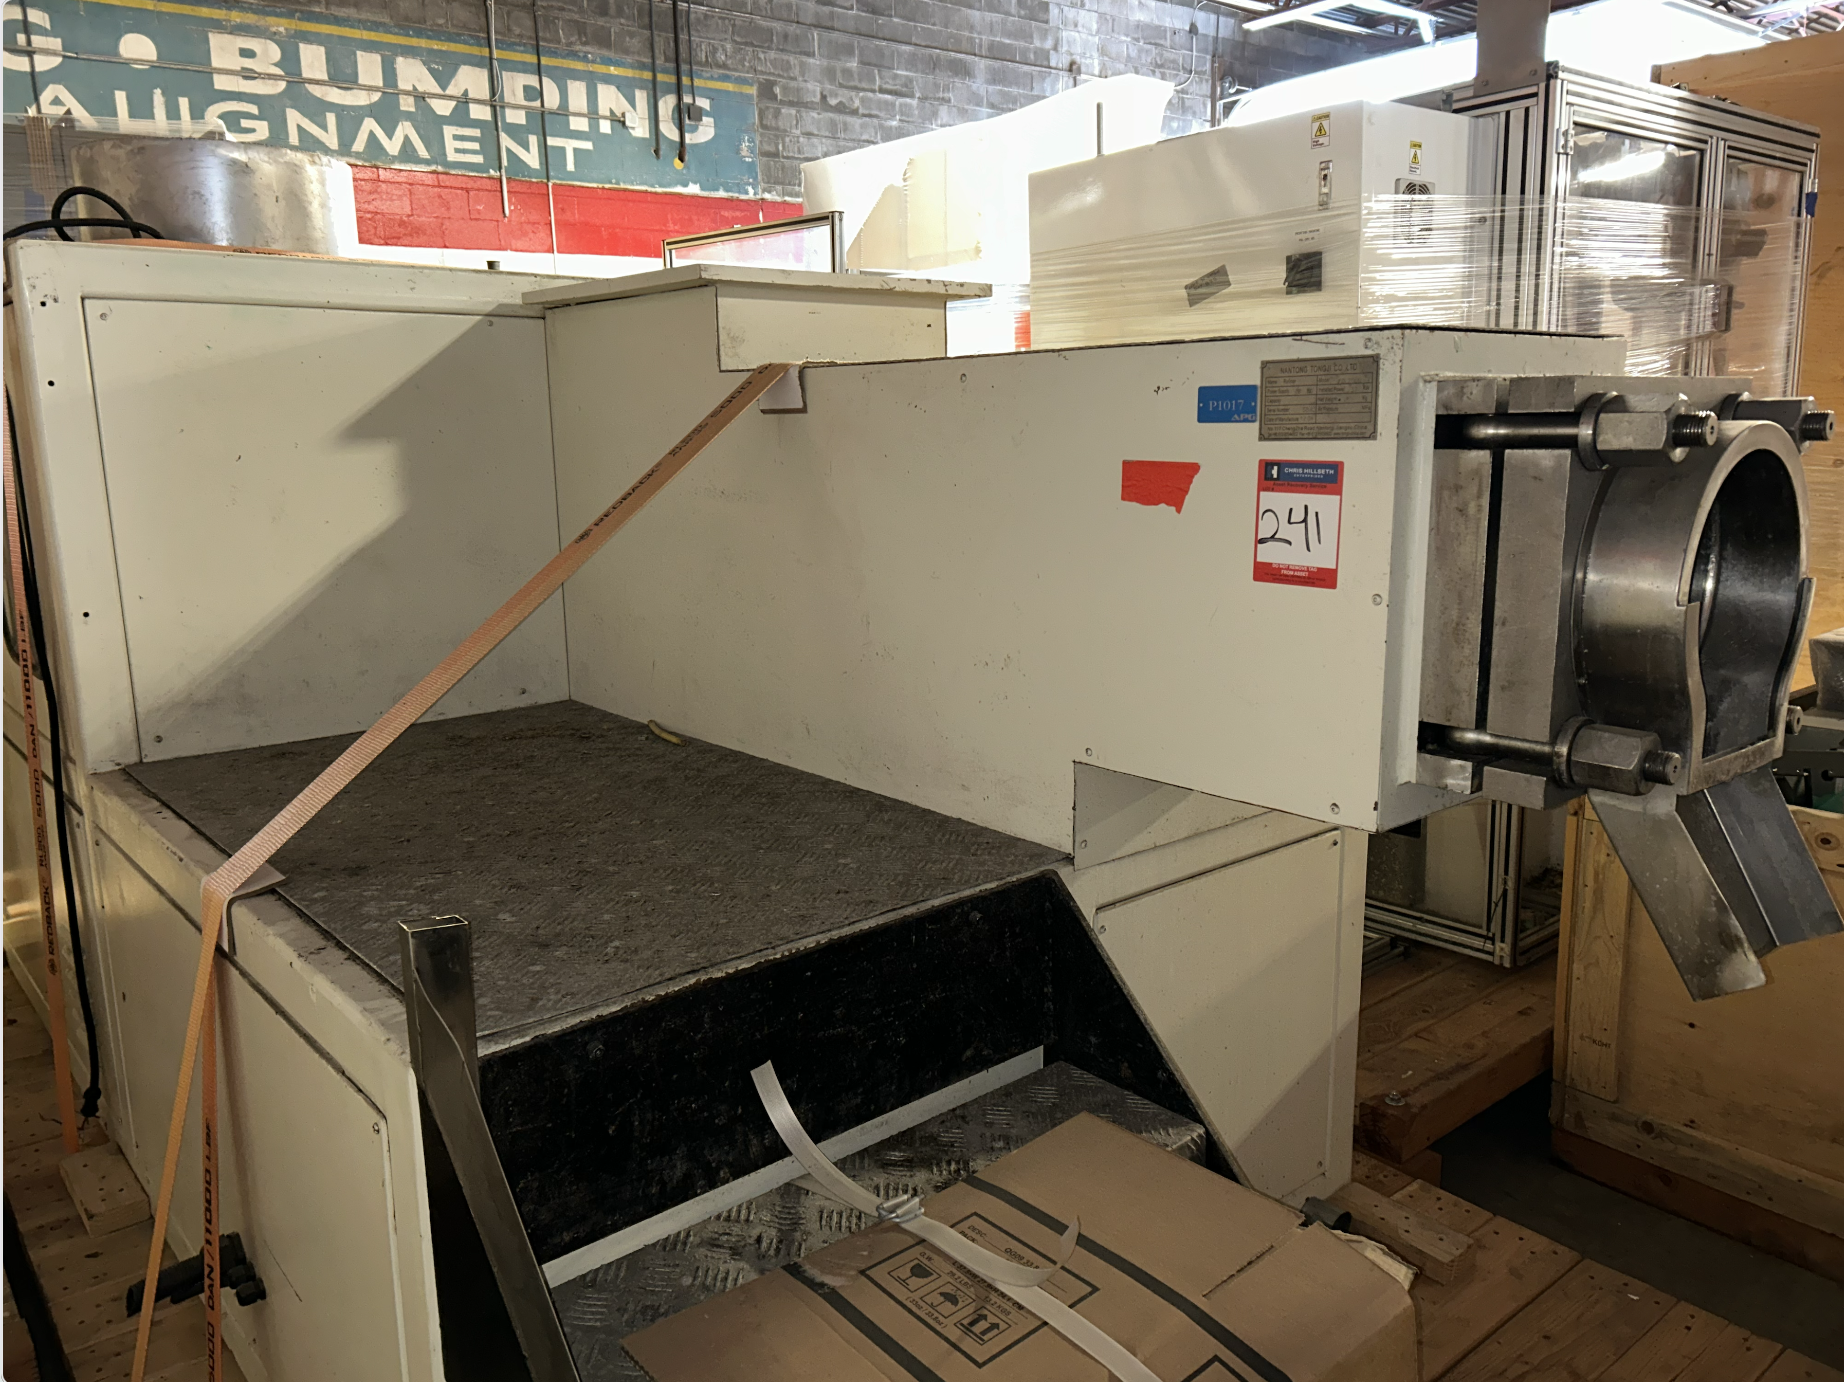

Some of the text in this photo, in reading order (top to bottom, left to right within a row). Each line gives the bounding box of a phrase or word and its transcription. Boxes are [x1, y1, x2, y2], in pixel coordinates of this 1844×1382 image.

[207, 31, 716, 145] BUMPING
[1280, 366, 1308, 374] NANTONG
[1310, 364, 1331, 373] TONGJI
[1209, 400, 1244, 411] P1017
[594, 382, 752, 526] REDBACK 5000
[1258, 504, 1321, 552] 241
[33, 769, 43, 818] 5000
[42, 885, 55, 956] REDBACK
[206, 1264, 214, 1311] DAN
[995, 1304, 1012, 1316] KGS
